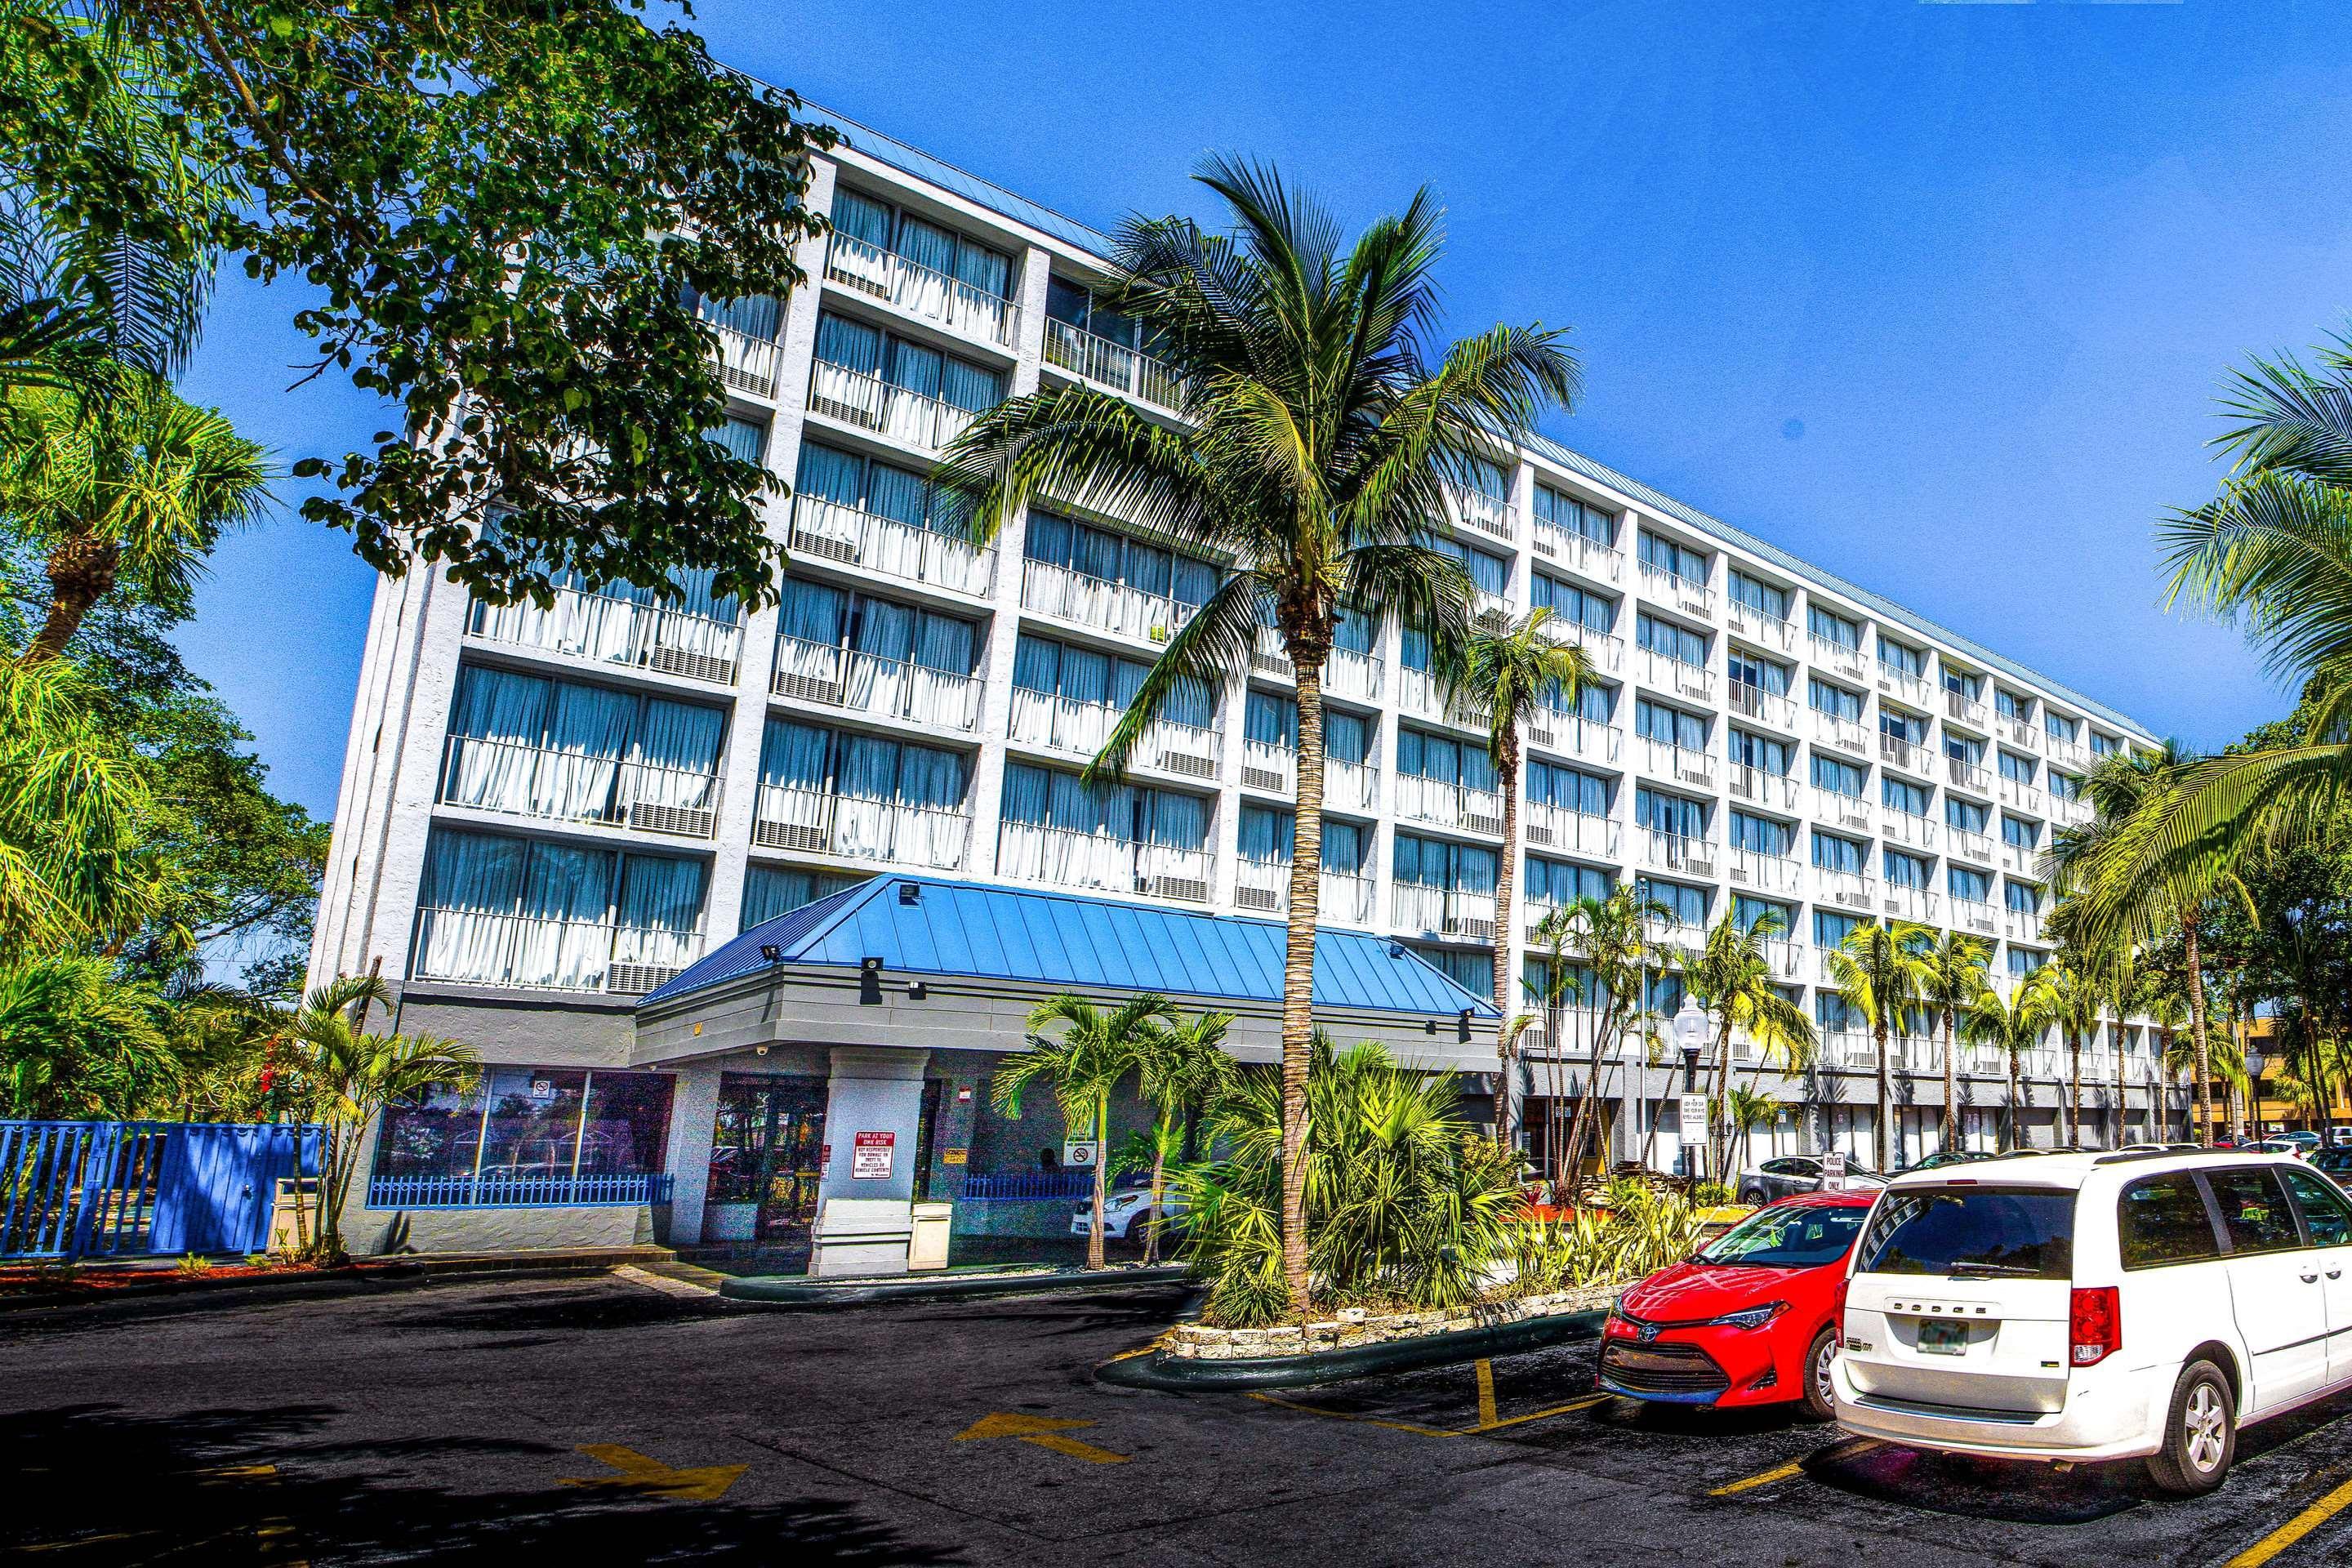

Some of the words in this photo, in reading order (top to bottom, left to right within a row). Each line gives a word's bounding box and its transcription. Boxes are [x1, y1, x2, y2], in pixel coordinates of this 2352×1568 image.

[1827, 1157, 1841, 1165] POLICE
[1824, 1169, 1843, 1178] PARKING
[1829, 1182, 1840, 1191] ONLY
[1894, 1303, 1986, 1314] DODGE
